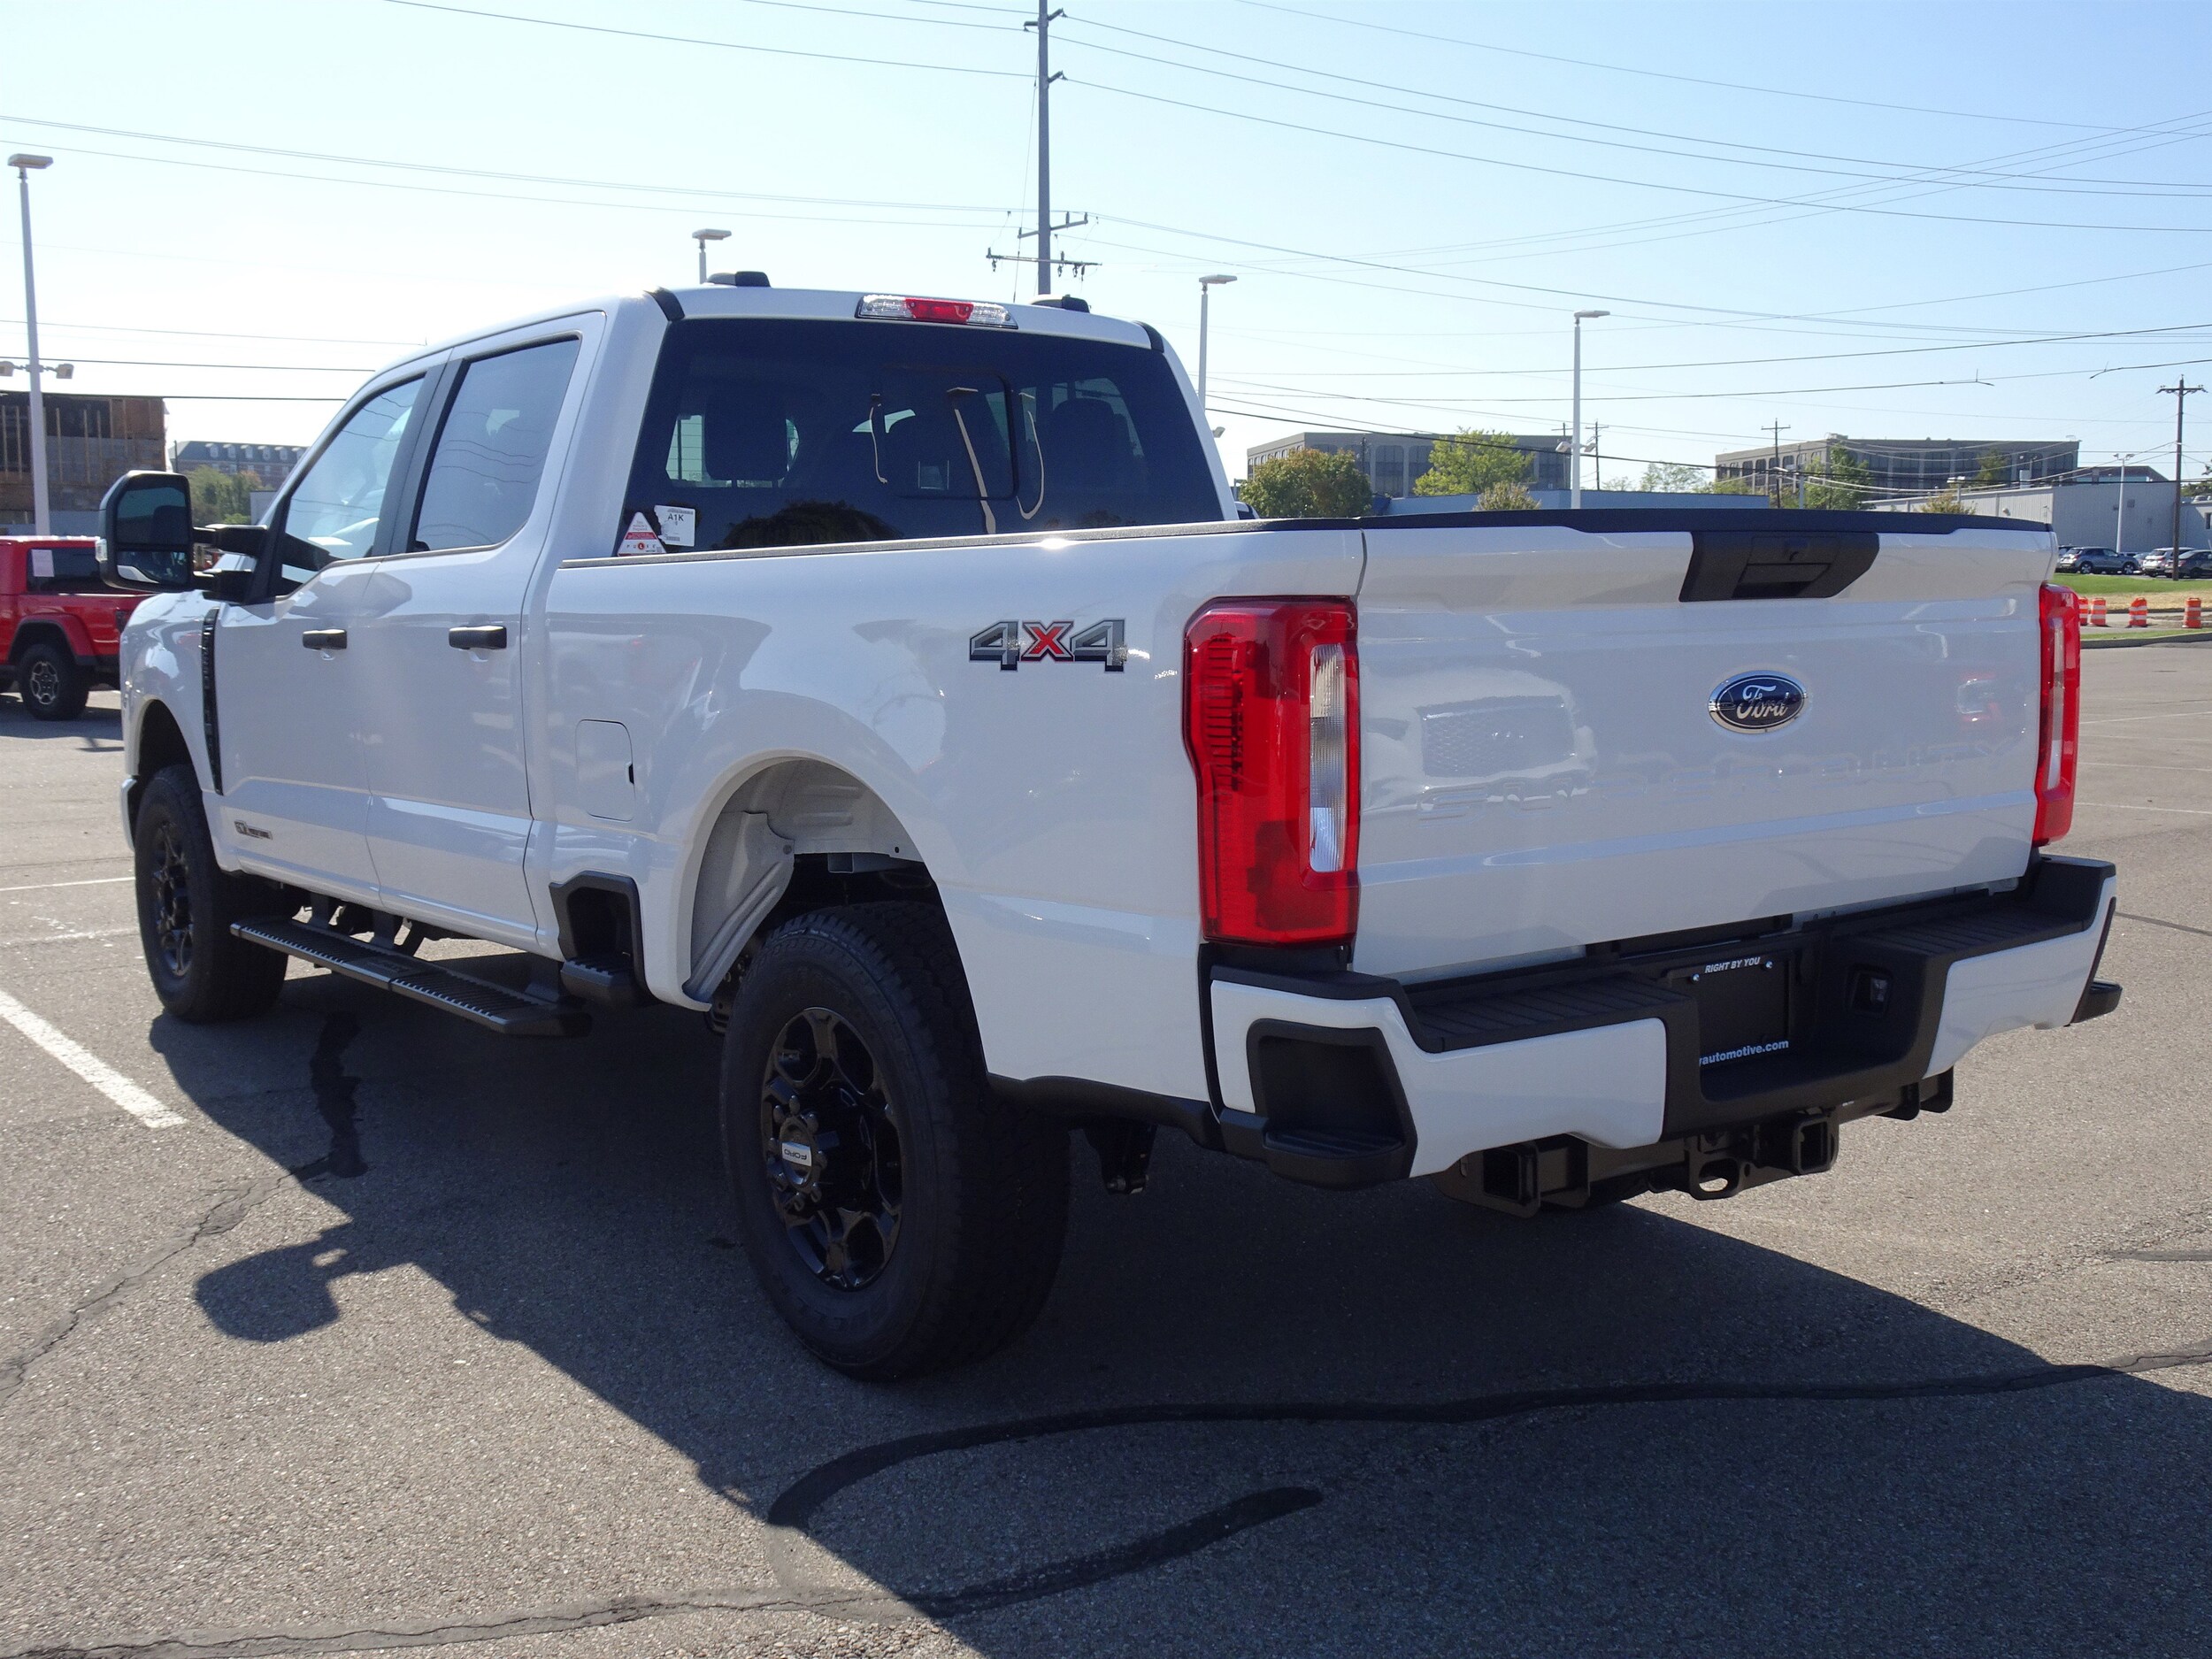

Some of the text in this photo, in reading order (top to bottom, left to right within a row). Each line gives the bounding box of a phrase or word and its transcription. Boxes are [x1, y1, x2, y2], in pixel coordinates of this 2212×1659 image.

[668, 513, 684, 522] A1K
[1736, 684, 1789, 719] Ford
[1704, 956, 1761, 973] RIGHT BY YOU
[784, 1149, 807, 1160] FORD
